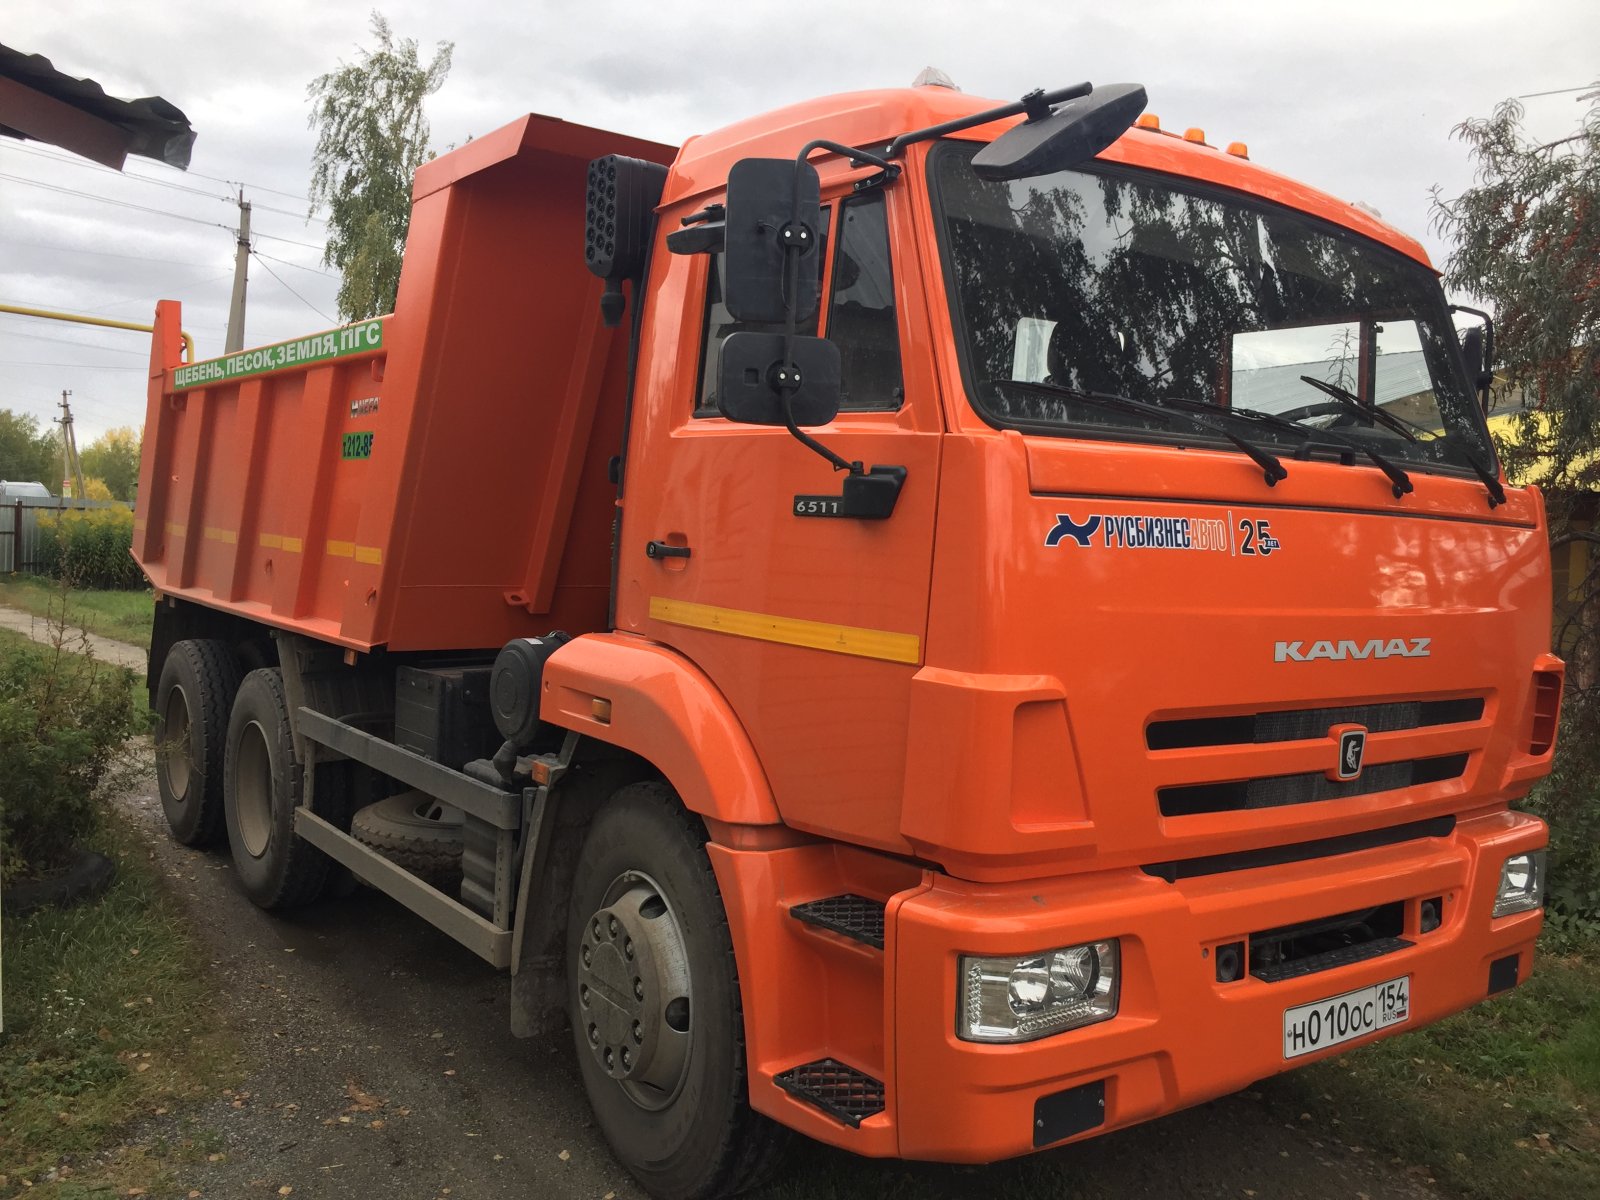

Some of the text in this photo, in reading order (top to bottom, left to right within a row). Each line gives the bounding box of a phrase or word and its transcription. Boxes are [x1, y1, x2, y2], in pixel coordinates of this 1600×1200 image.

[175, 322, 380, 386] ЩЕБЕНЬ, ПЕСОК, ЗЕМЛЯ, ПГС
[1104, 515, 1228, 551] РУСБИЗНЕСАВТО
[1239, 518, 1273, 556] 25
[1274, 638, 1432, 662] KAMAZ
[1378, 981, 1408, 1013] 154
[1382, 1009, 1397, 1023] RUS
